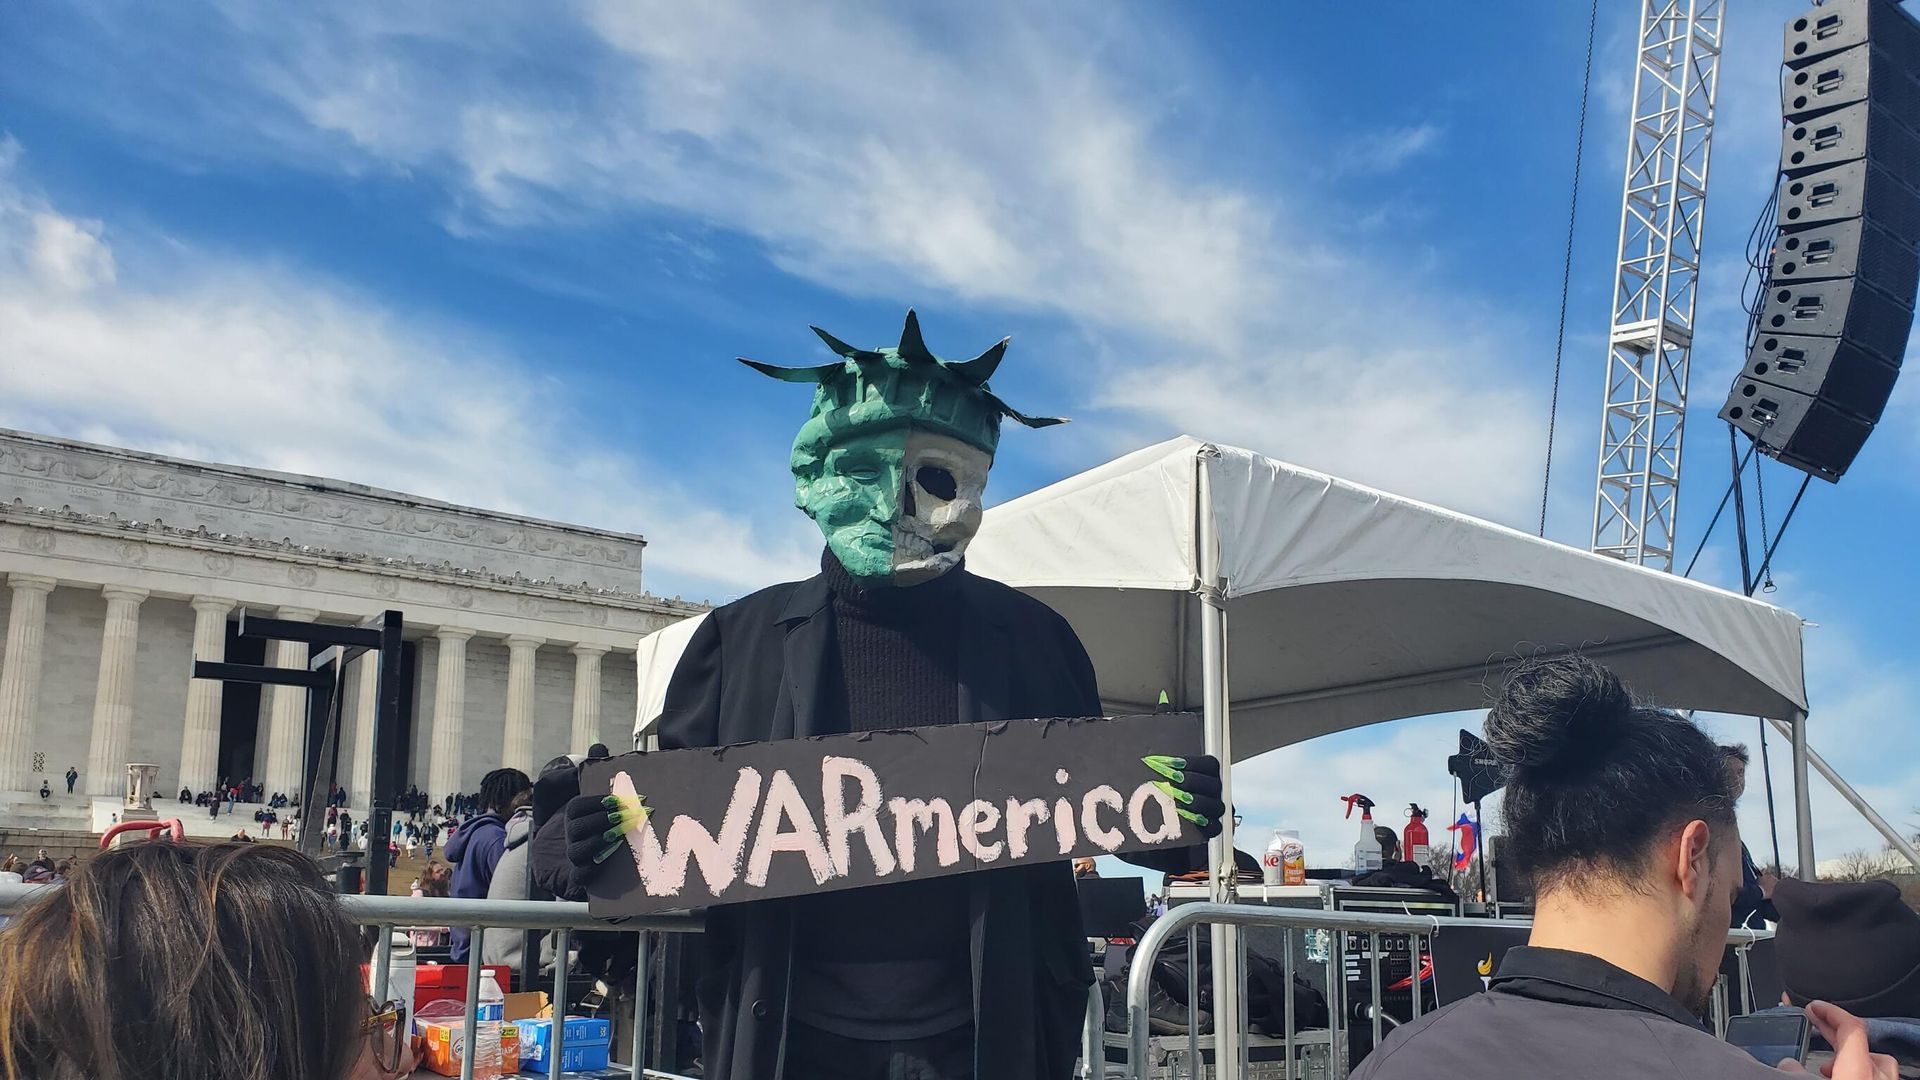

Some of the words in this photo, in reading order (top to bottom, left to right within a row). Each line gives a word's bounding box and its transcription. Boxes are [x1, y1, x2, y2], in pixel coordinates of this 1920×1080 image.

[66, 486, 103, 497] FLORIDA
[1474, 758, 1498, 766] SHURE
[610, 755, 1181, 897] WARmerica
